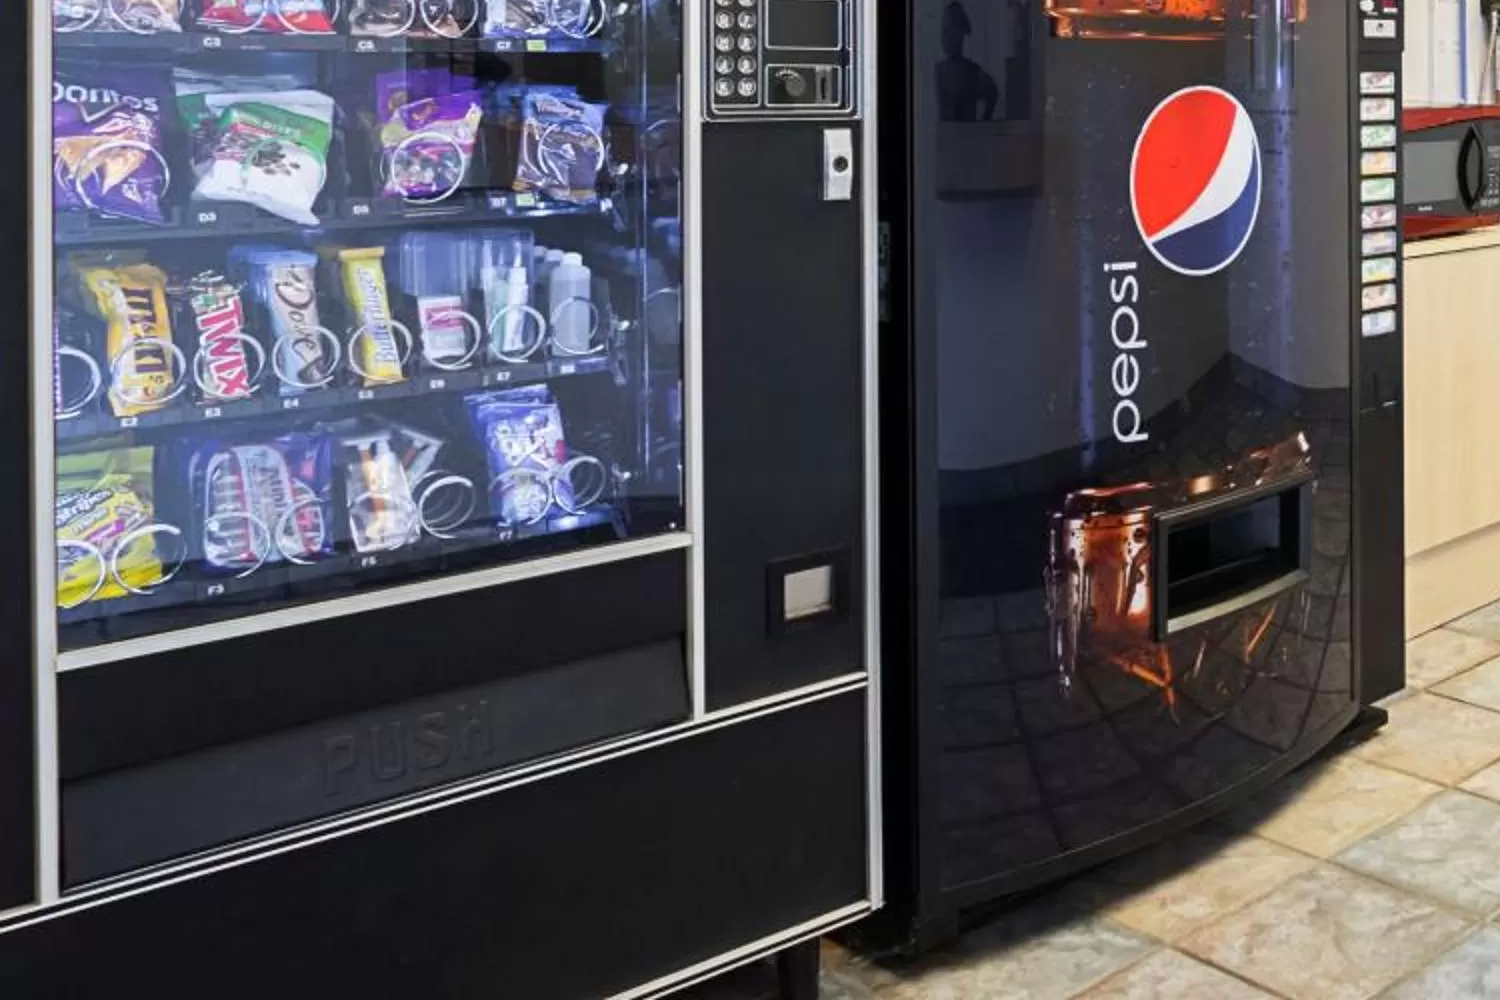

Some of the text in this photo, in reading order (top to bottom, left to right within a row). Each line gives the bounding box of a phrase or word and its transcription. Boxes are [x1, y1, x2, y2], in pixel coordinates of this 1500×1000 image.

[200, 299, 249, 397] TWIX
[1103, 260, 1149, 444] pepsi
[323, 701, 498, 797] PUSH
